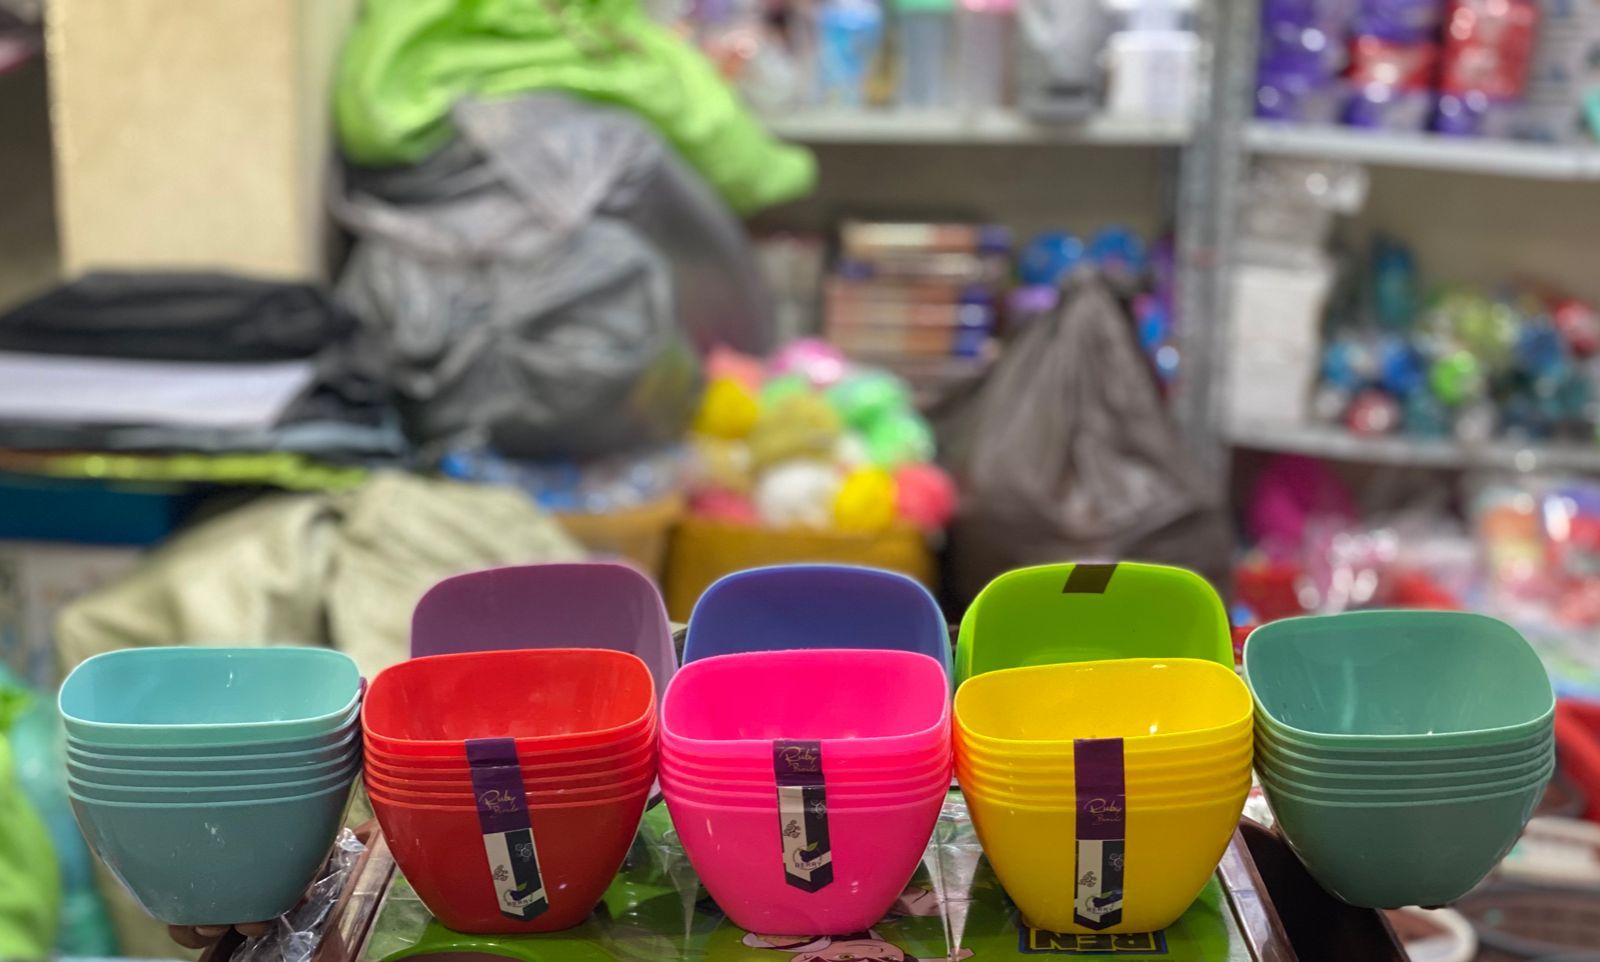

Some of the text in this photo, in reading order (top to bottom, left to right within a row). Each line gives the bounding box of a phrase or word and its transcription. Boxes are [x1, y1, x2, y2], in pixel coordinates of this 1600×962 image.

[779, 746, 817, 767] Ruby
[479, 790, 517, 810] Ruby
[1083, 798, 1122, 815] Ruby
